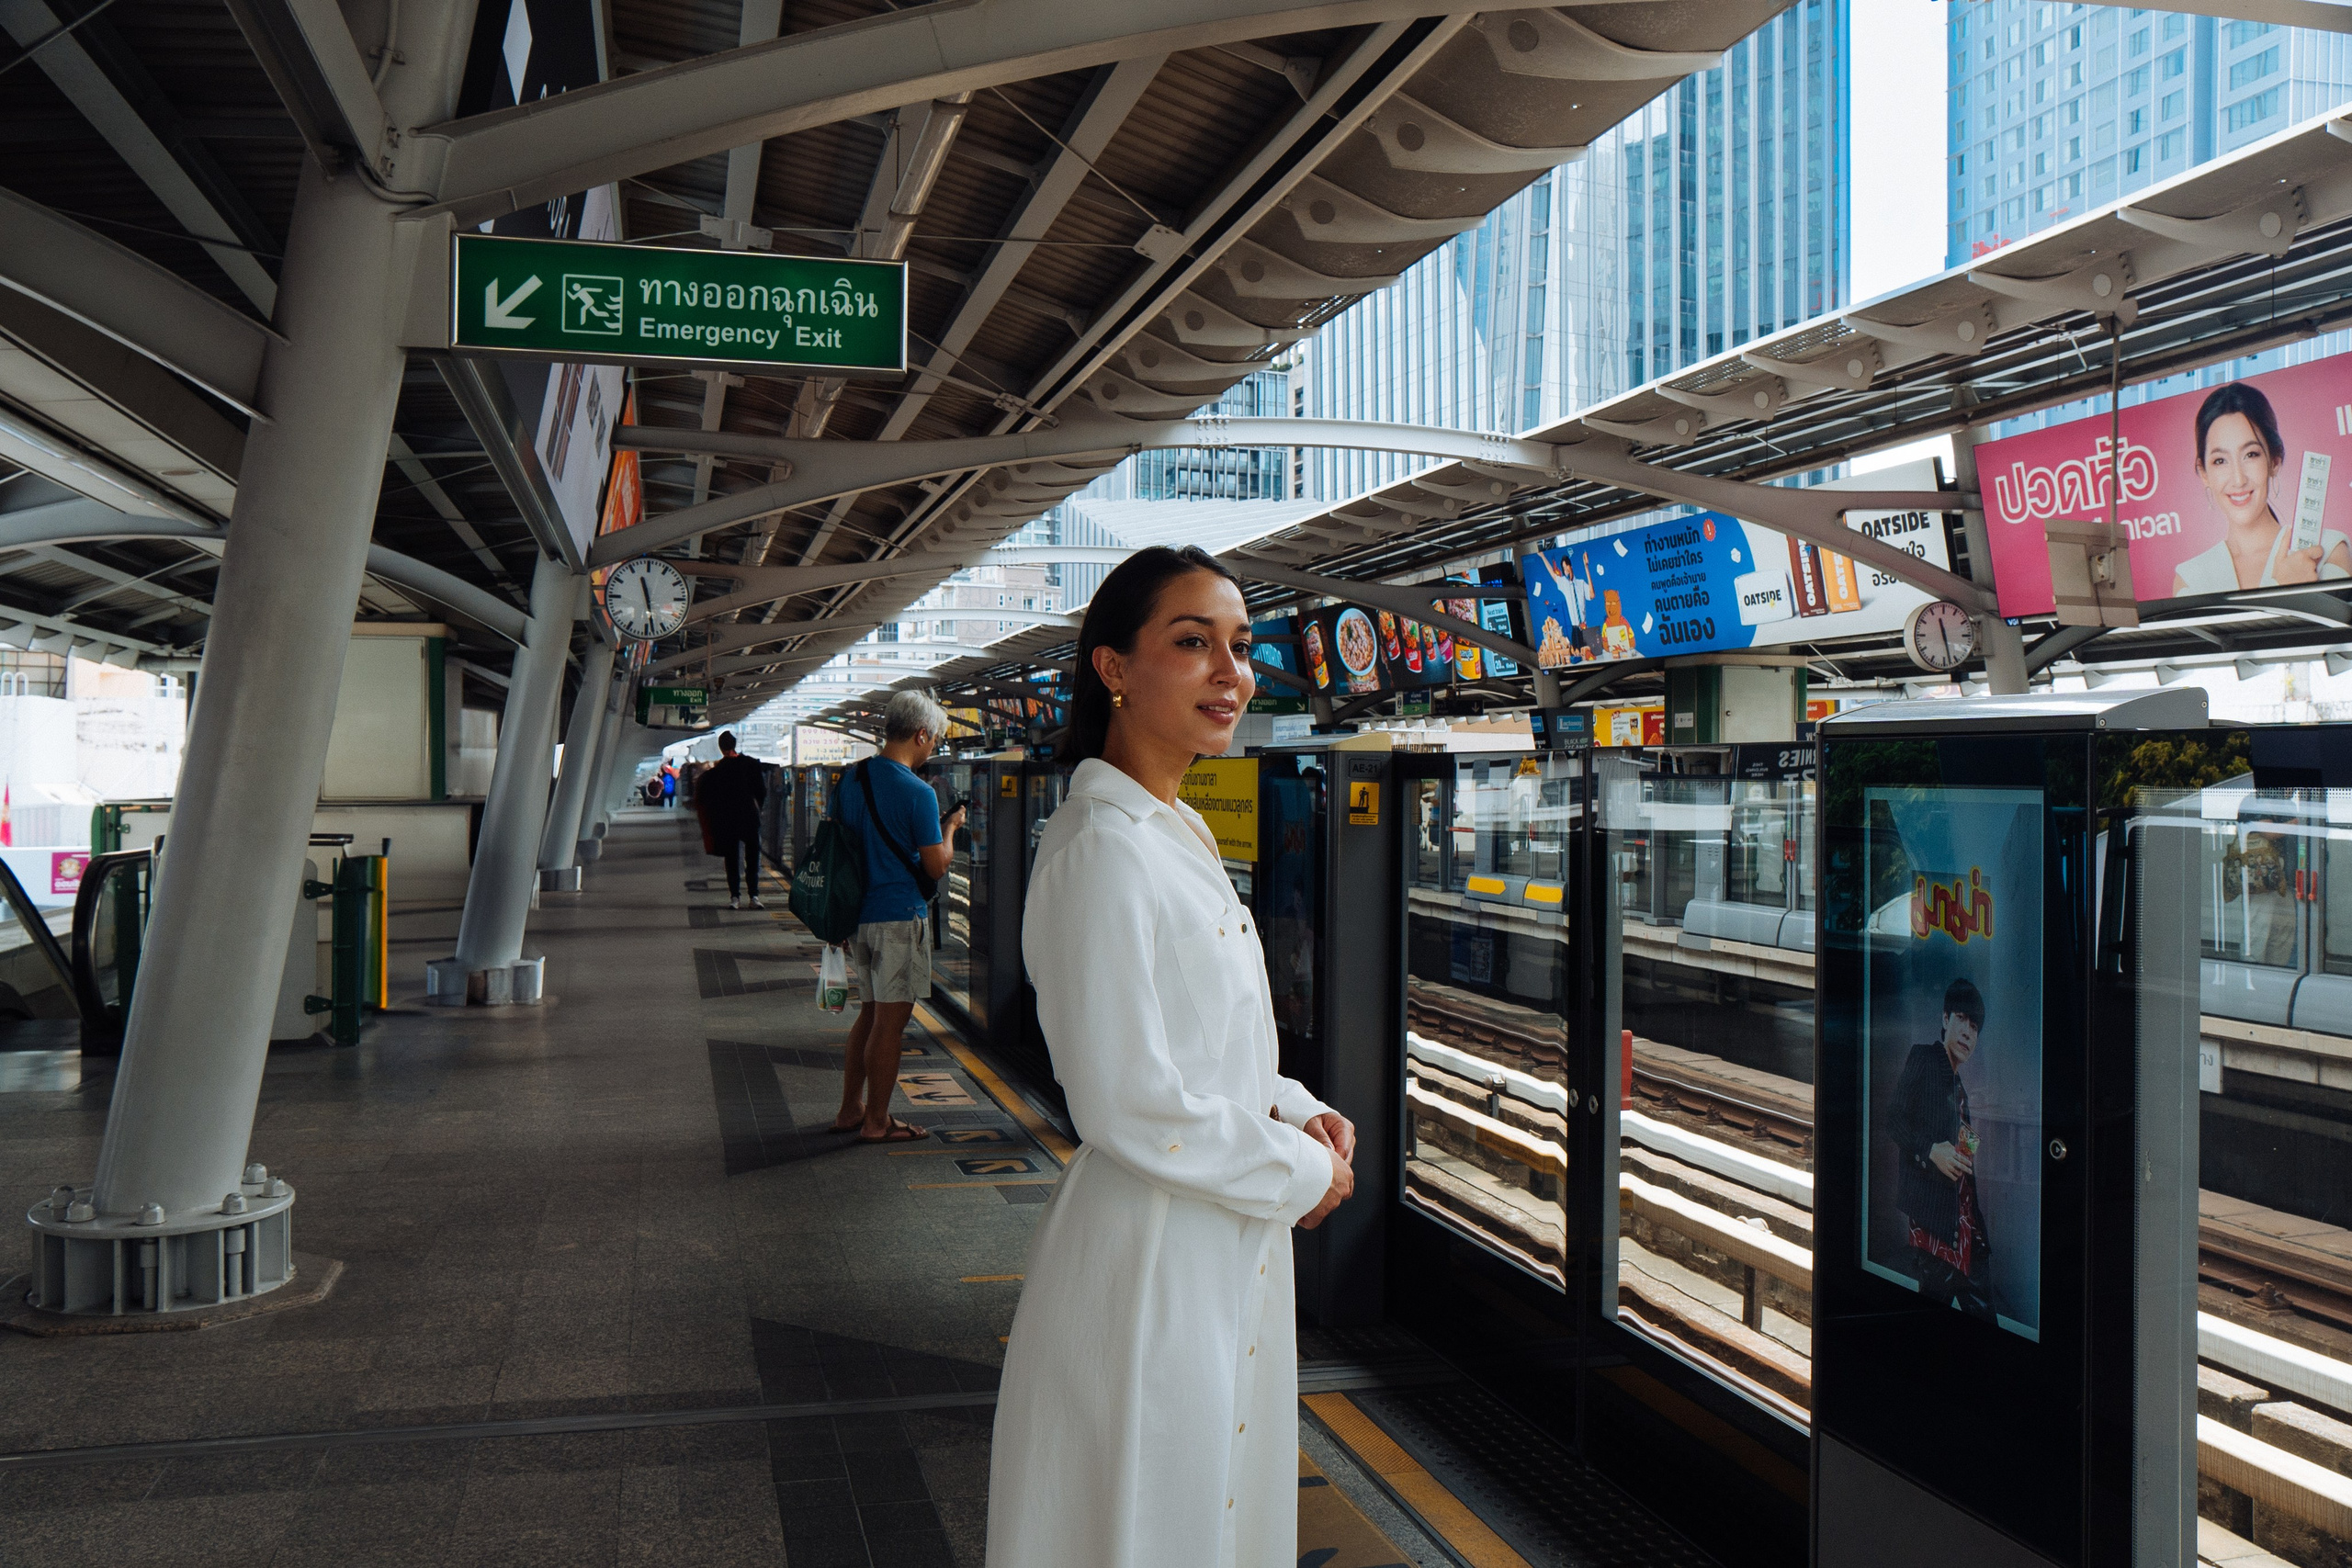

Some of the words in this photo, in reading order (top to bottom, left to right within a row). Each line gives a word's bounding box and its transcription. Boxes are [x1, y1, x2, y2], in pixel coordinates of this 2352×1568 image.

[639, 277, 879, 329] ทางออกฉุกเฉิน
[639, 316, 781, 350] Emergency
[795, 325, 842, 349] Exit
[1861, 512, 1931, 539] OATSIDE
[1644, 525, 1701, 555] ทำงานหนัก
[1645, 551, 1703, 573] ไม่เคยฆ่าใคร
[1655, 585, 1710, 613] คนตายคือ
[1744, 589, 1781, 606] OATSIDE
[1657, 614, 1716, 646] ฉันเอง
[1351, 763, 1378, 773] AE-21
